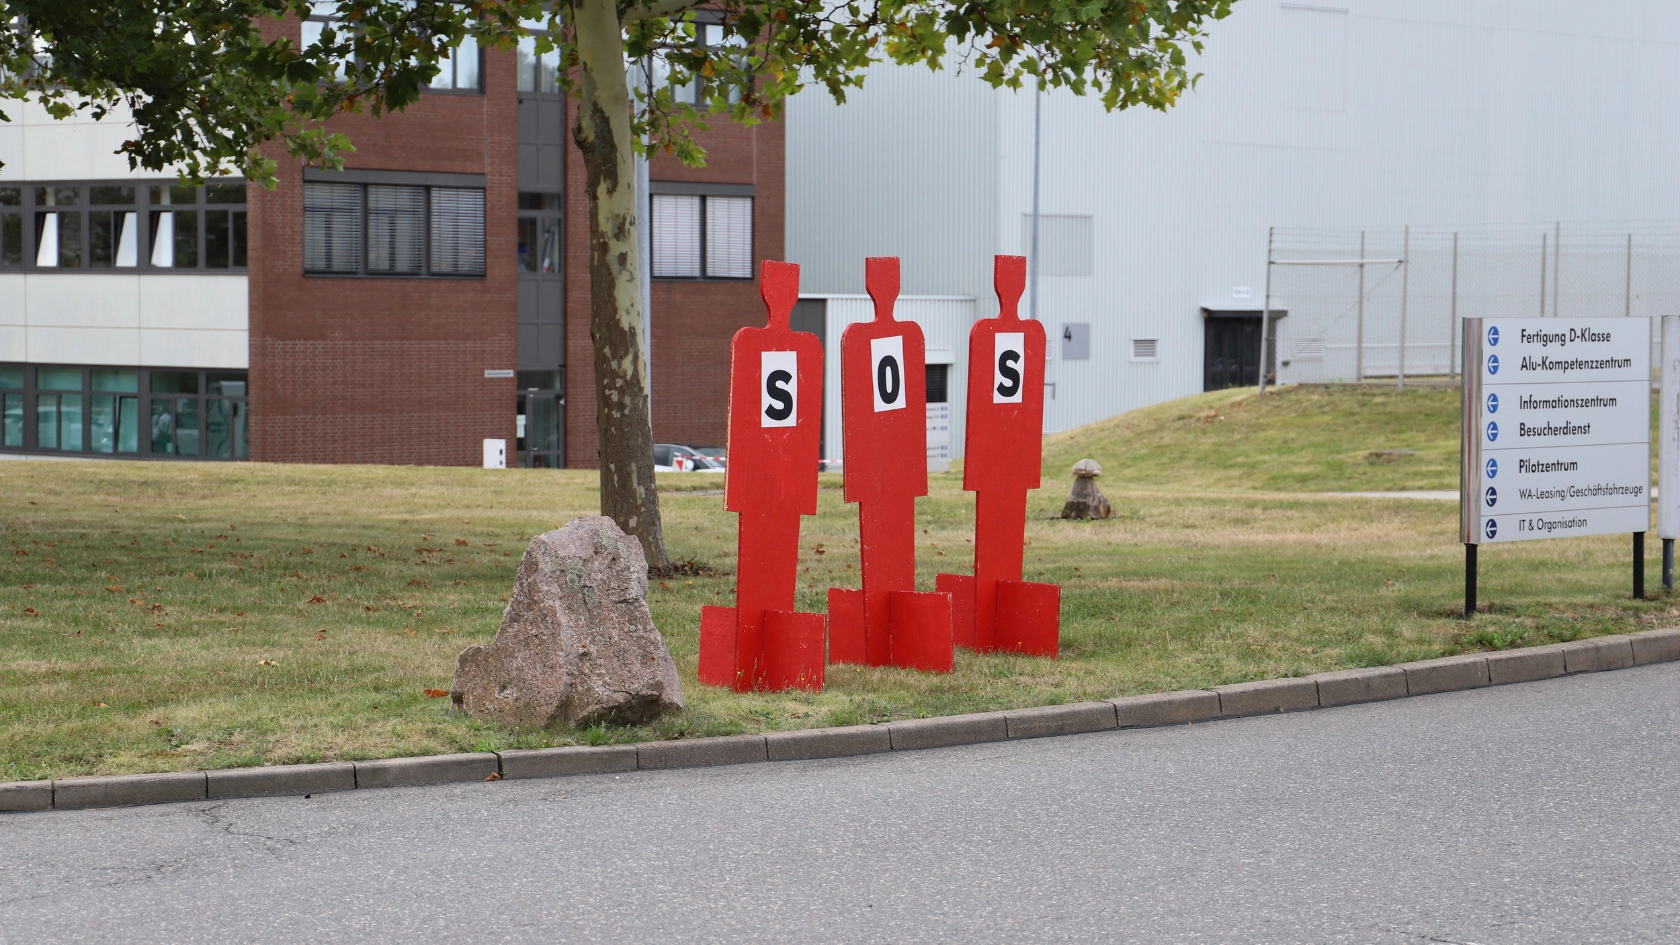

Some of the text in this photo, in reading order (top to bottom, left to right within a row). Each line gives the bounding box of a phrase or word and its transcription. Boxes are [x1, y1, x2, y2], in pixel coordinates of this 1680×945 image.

[1064, 326, 1071, 342] 4
[1521, 327, 1611, 347] Fertigung D-Klasse
[996, 349, 1021, 397] S
[1520, 356, 1631, 373] Alu-Kompetenzzentrum
[764, 369, 793, 421] S
[1519, 394, 1617, 410] Informationszentrum
[1519, 420, 1591, 437] Besucherdienst
[1519, 458, 1578, 474] Pilotzentrum
[1519, 483, 1643, 501] WA-Leasing/Geschäftsfahrzeuge
[1519, 517, 1587, 533] IT & Organisation
